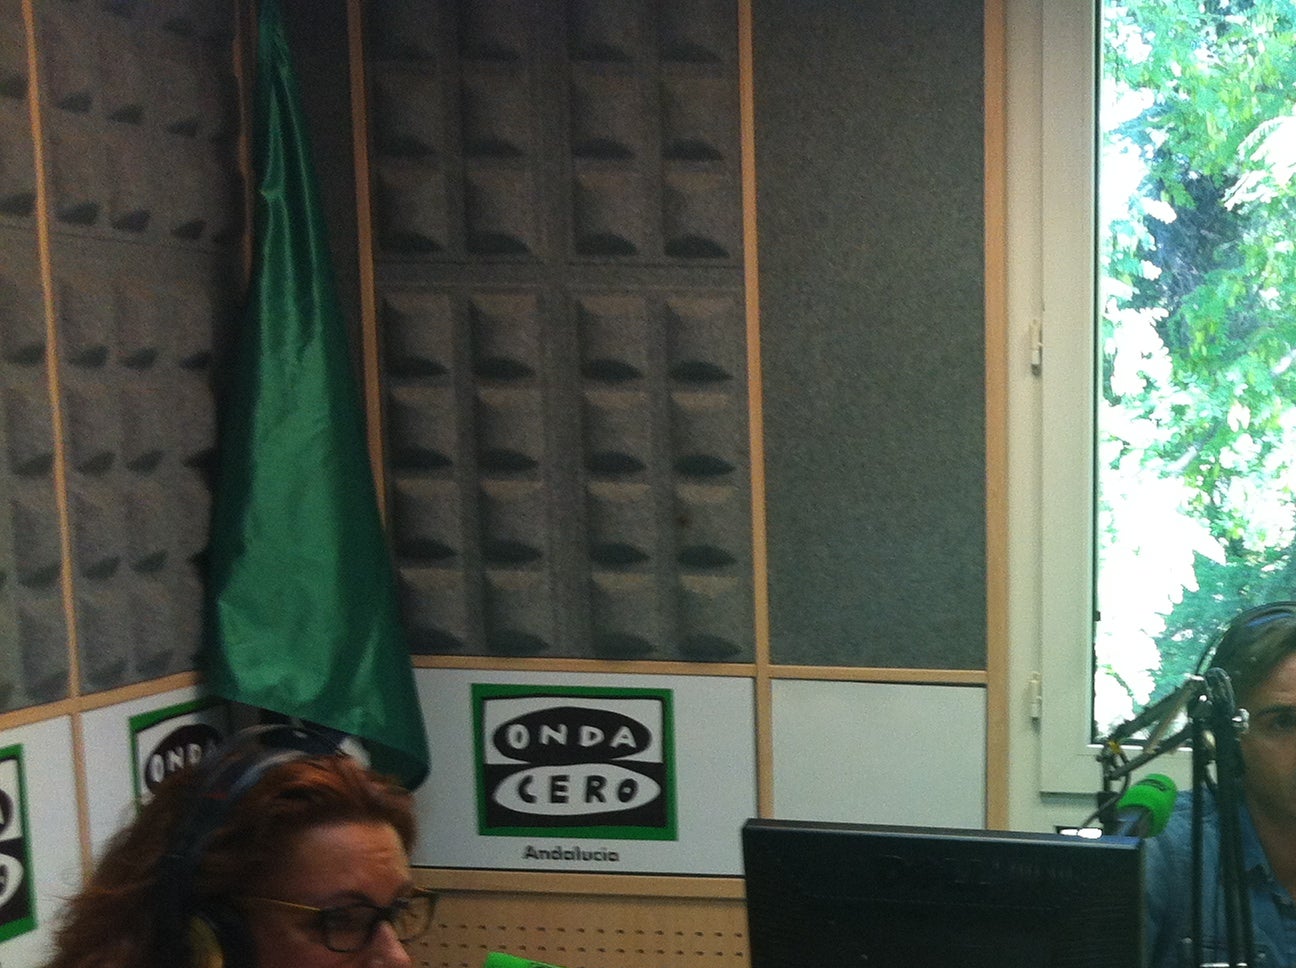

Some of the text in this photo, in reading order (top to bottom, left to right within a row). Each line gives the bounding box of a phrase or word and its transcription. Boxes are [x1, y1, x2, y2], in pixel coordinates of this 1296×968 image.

[503, 722, 637, 750] ONDA
[149, 742, 204, 783] OND
[517, 774, 640, 805] CERO
